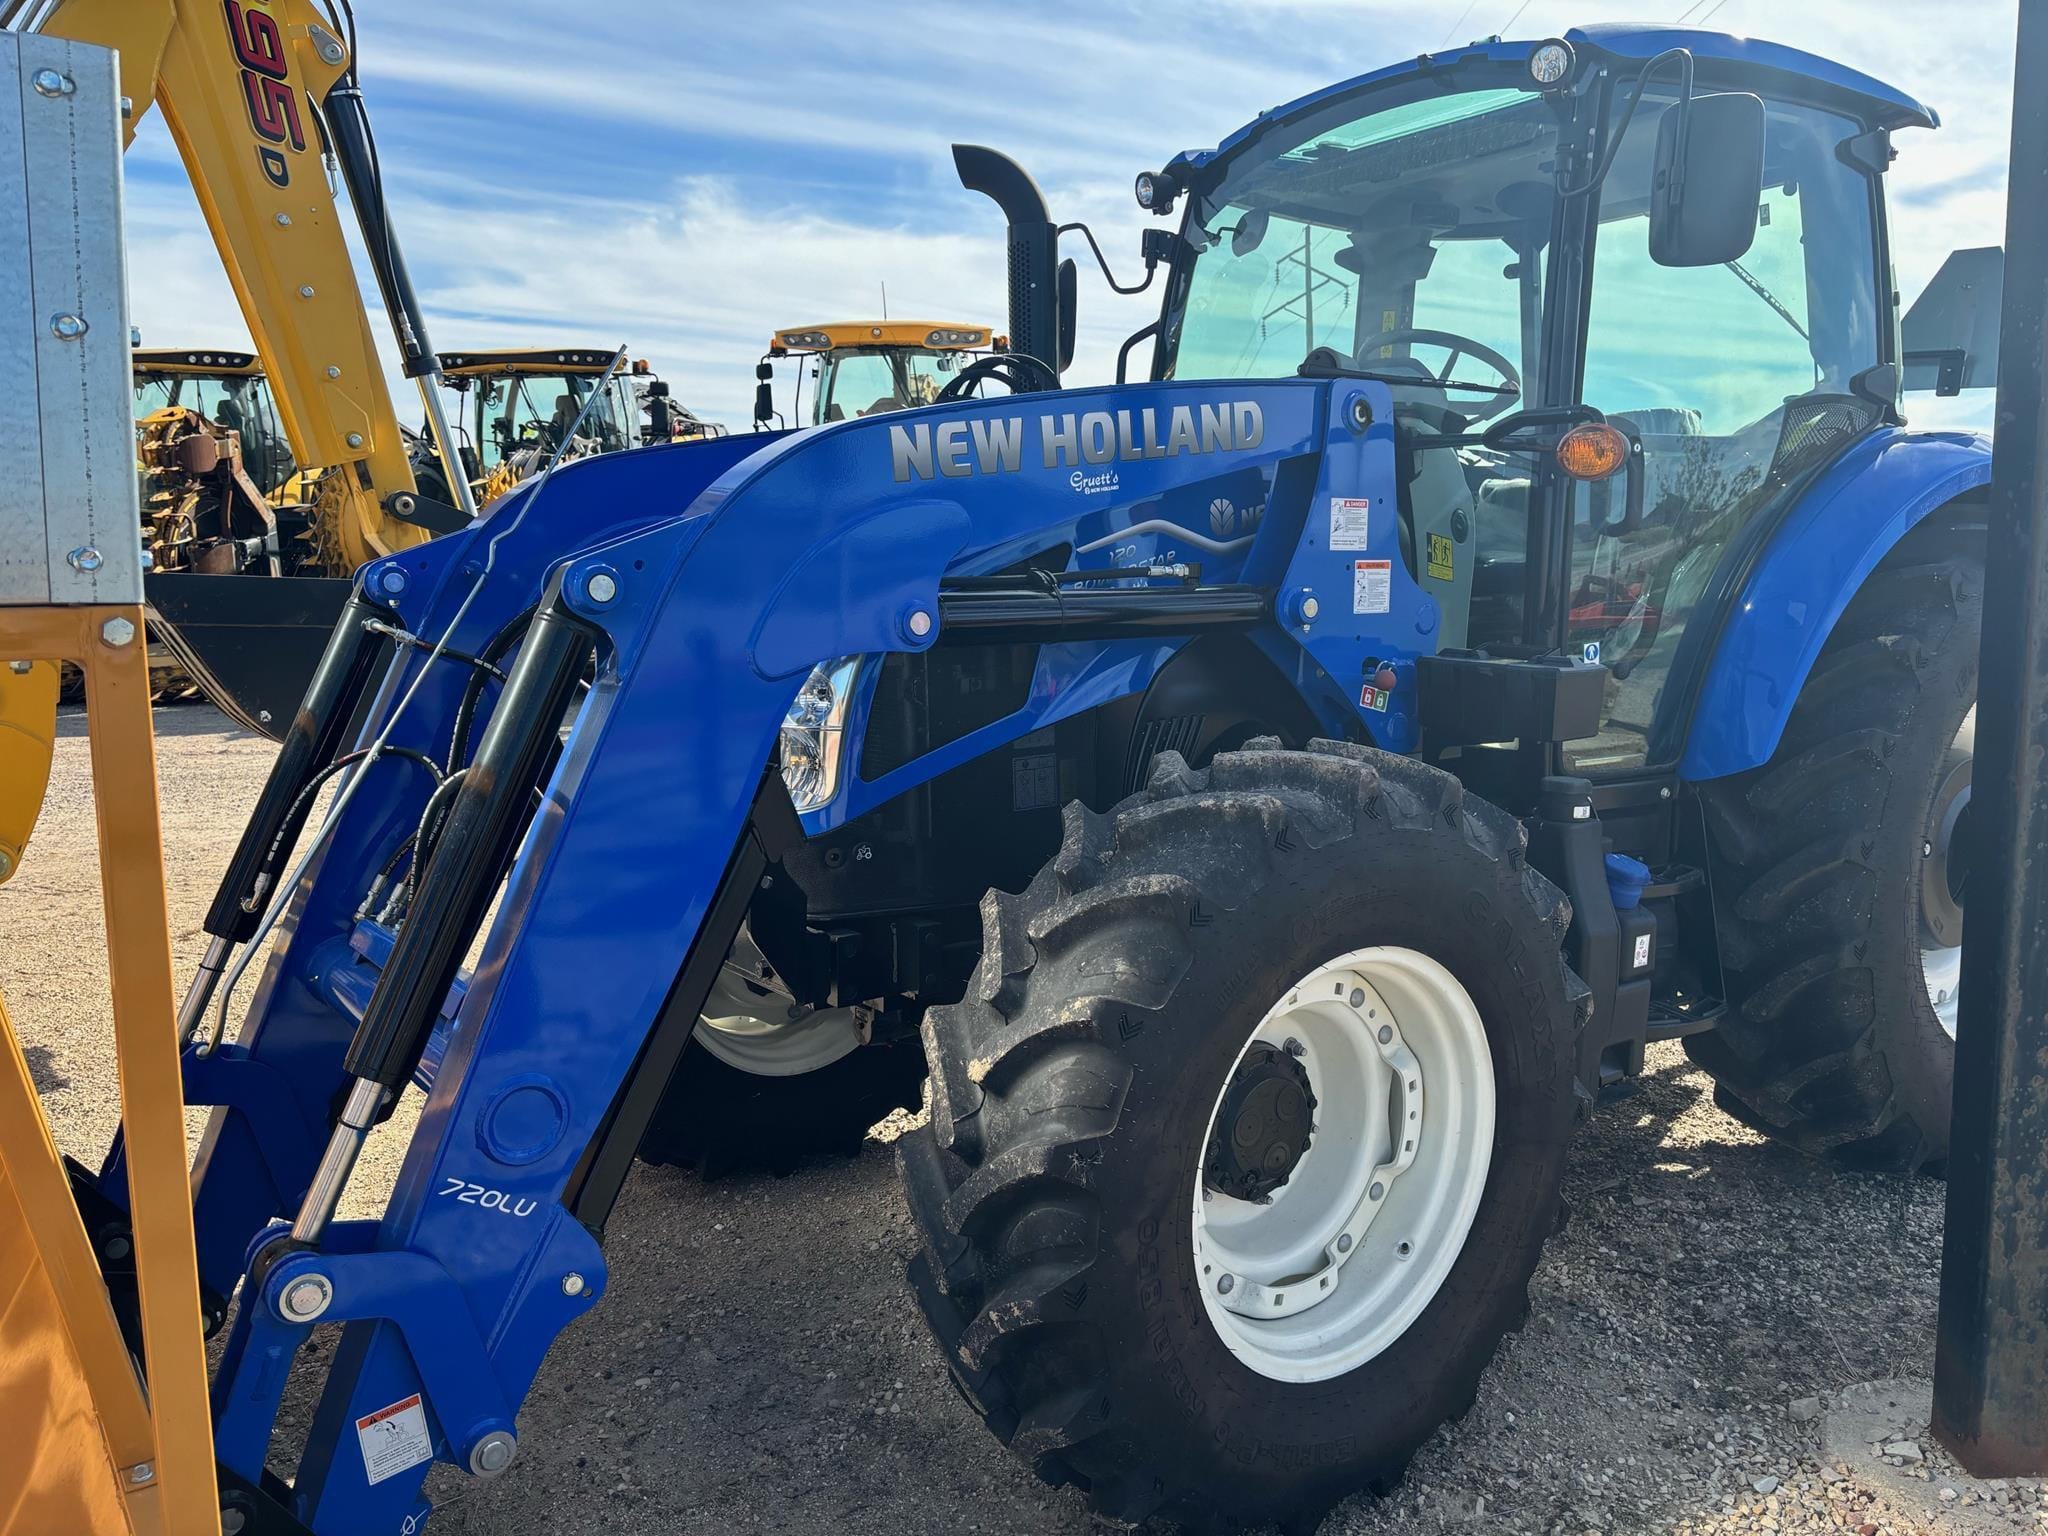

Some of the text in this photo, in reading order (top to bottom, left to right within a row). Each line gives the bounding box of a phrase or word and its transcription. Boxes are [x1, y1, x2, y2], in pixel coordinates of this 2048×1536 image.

[889, 400, 1264, 483] NEW HOLLAND
[1069, 469, 1119, 491] Gruett's
[1462, 888, 1558, 1101] GALAXY
[437, 1177, 538, 1217] 720LU
[1136, 1216, 1162, 1312] 850
[379, 1401, 411, 1419] WARNING
